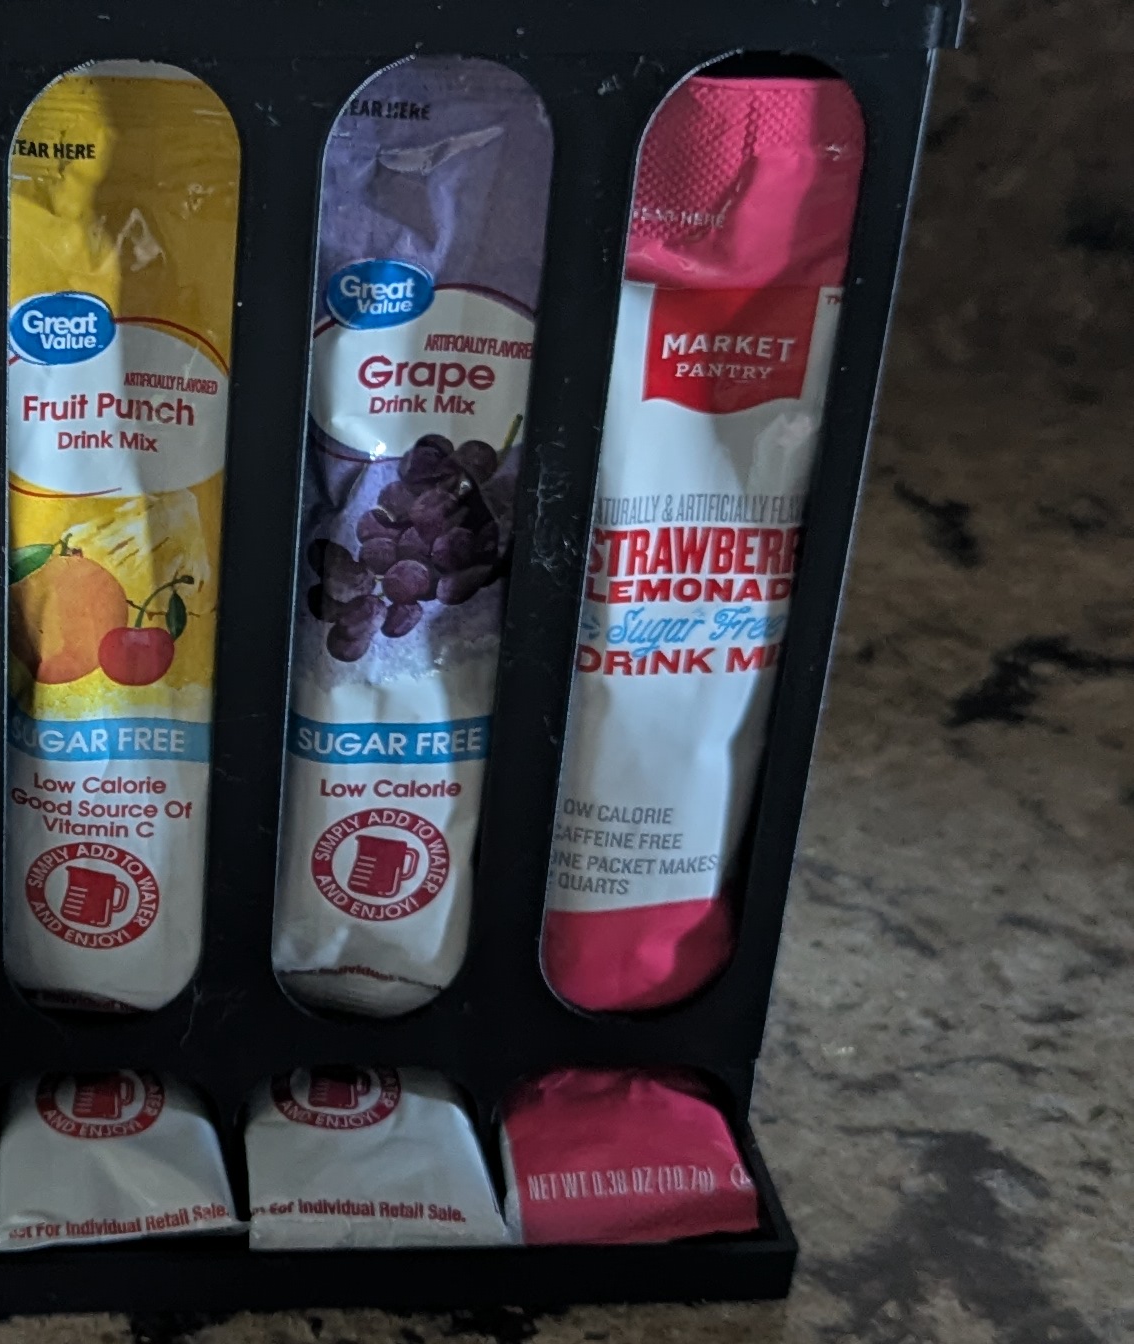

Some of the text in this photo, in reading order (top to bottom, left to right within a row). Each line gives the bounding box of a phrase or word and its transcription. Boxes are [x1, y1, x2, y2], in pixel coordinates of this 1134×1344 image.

[53, 143, 96, 159] HERE
[340, 275, 416, 300] Great
[357, 297, 414, 315] Value
[22, 309, 99, 336] Great
[41, 332, 98, 350] Value
[424, 333, 487, 356] ARTIFICIALLY
[661, 333, 798, 362] MARKET
[123, 372, 218, 396] ARTIFICIALLY FLAVORED
[357, 354, 496, 395] Grape
[674, 362, 773, 381] PANTRY
[22, 392, 195, 427] Fruit Punch
[368, 394, 475, 416] Drink Mix
[57, 430, 158, 453] Drink Mix
[662, 495, 673, 523] &
[674, 492, 768, 524] ARTIFICIALLY
[584, 577, 792, 604] LEMONAD
[605, 606, 786, 659] Sugar Free
[575, 644, 716, 676] DRINK
[11, 715, 186, 753] SUGAR FREE
[297, 726, 482, 757] SUGAR FREE
[33, 772, 167, 795] Low Calorie
[319, 778, 463, 799] Low Calorie
[10, 787, 193, 820] Good Source Of
[597, 805, 674, 825] CALORIE
[42, 814, 156, 839] Vitamin C
[313, 810, 447, 895] SIMPLY ADD TO WATER
[637, 833, 684, 849] FREE
[587, 855, 656, 875] PACKET
[658, 854, 718, 875] MAKES
[27, 844, 157, 927] SIMPLY ADD TO WATER
[557, 872, 629, 895] QUARTS
[315, 875, 420, 920] AND ENJOY!
[29, 900, 133, 947] AND ENJOY!
[43, 1108, 75, 1132] AND
[526, 1173, 557, 1201] NET
[631, 1166, 654, 1194] OZ
[37, 1221, 61, 1237] For
[65, 1217, 143, 1236] Individual
[145, 1208, 190, 1231] Retail
[192, 1203, 230, 1221] Sale.
[297, 1199, 376, 1217] Individual
[379, 1201, 425, 1220] Retail
[428, 1204, 467, 1223] Sale.
